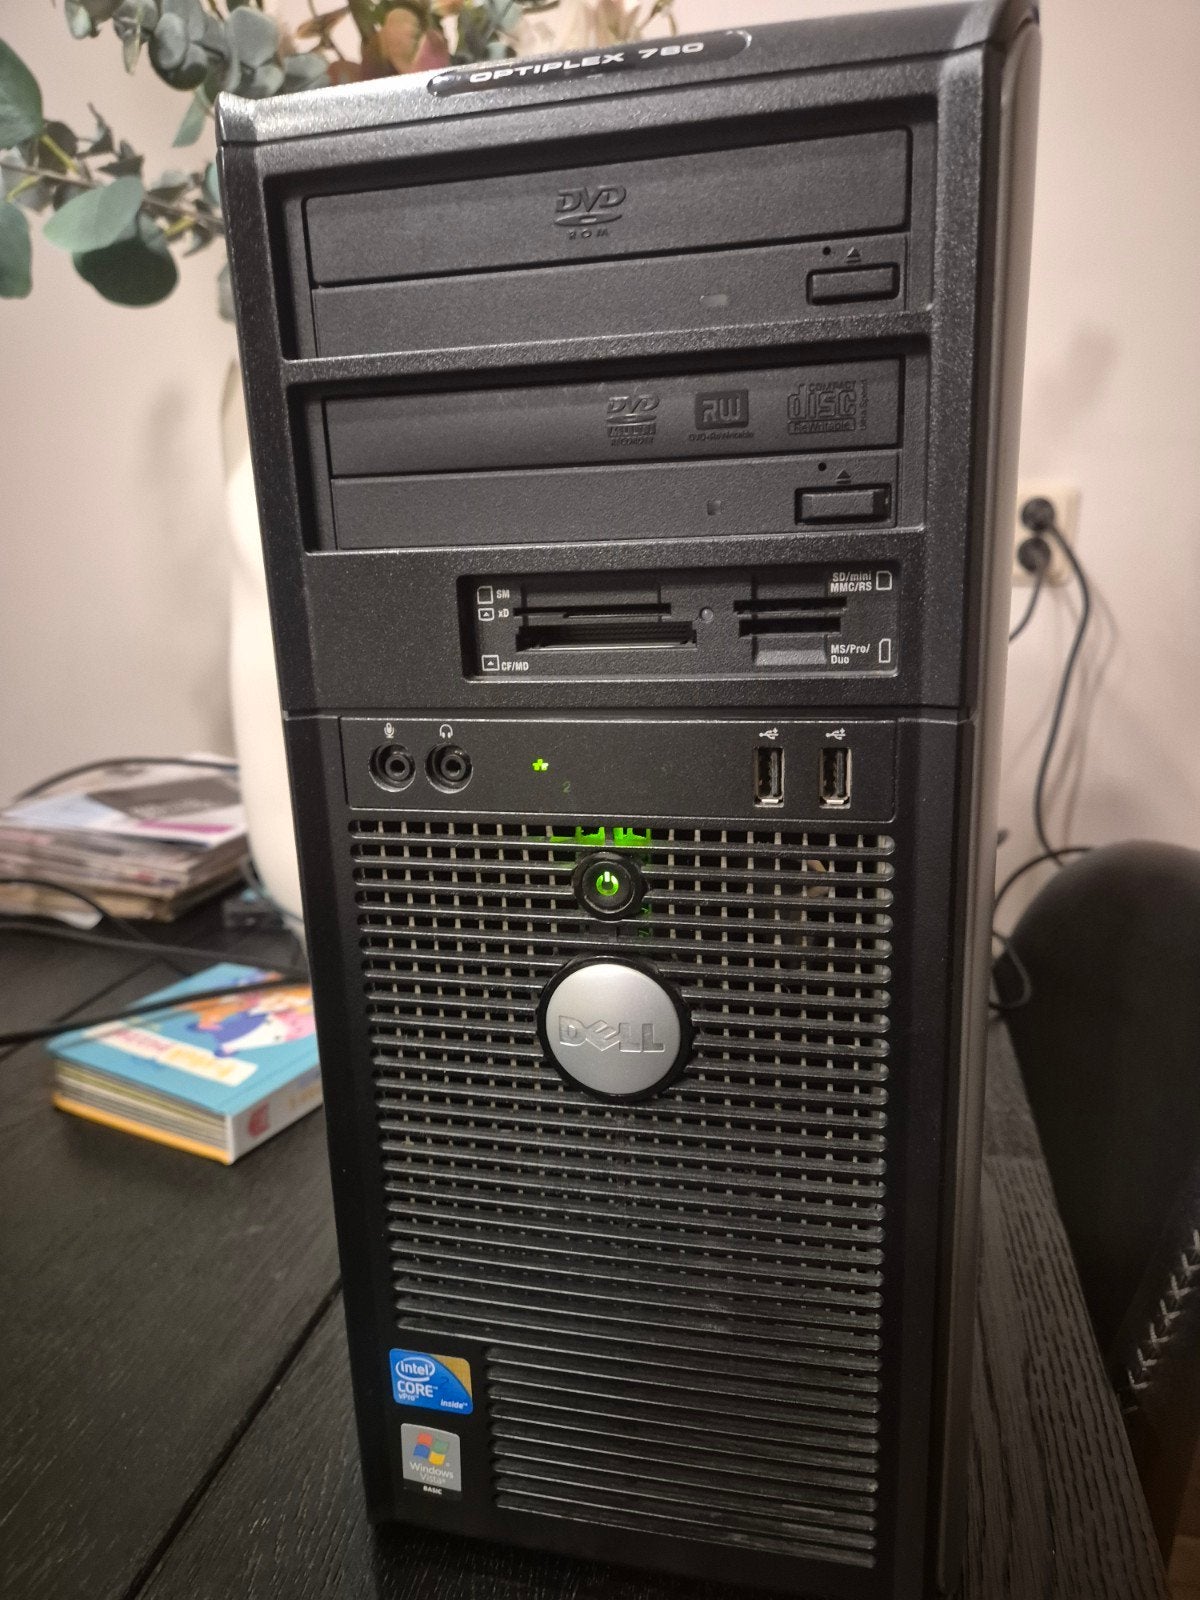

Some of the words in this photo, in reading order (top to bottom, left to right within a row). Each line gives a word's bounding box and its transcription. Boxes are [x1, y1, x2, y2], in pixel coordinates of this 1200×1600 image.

[469, 52, 625, 83] OPTIPLEX
[556, 184, 627, 212] DVD
[568, 228, 609, 240] ROM
[606, 394, 661, 413] DVD
[701, 397, 742, 423] RW
[832, 571, 872, 582] SD/mini
[830, 581, 872, 593] MMC/RS
[496, 589, 510, 599] SM
[831, 643, 870, 654] MS/Pro/
[831, 655, 850, 664] Duo
[501, 661, 529, 671] CF/MD
[558, 1015, 666, 1053] DELL
[410, 1461, 454, 1479] Windows
[423, 1485, 442, 1495] BASIC
